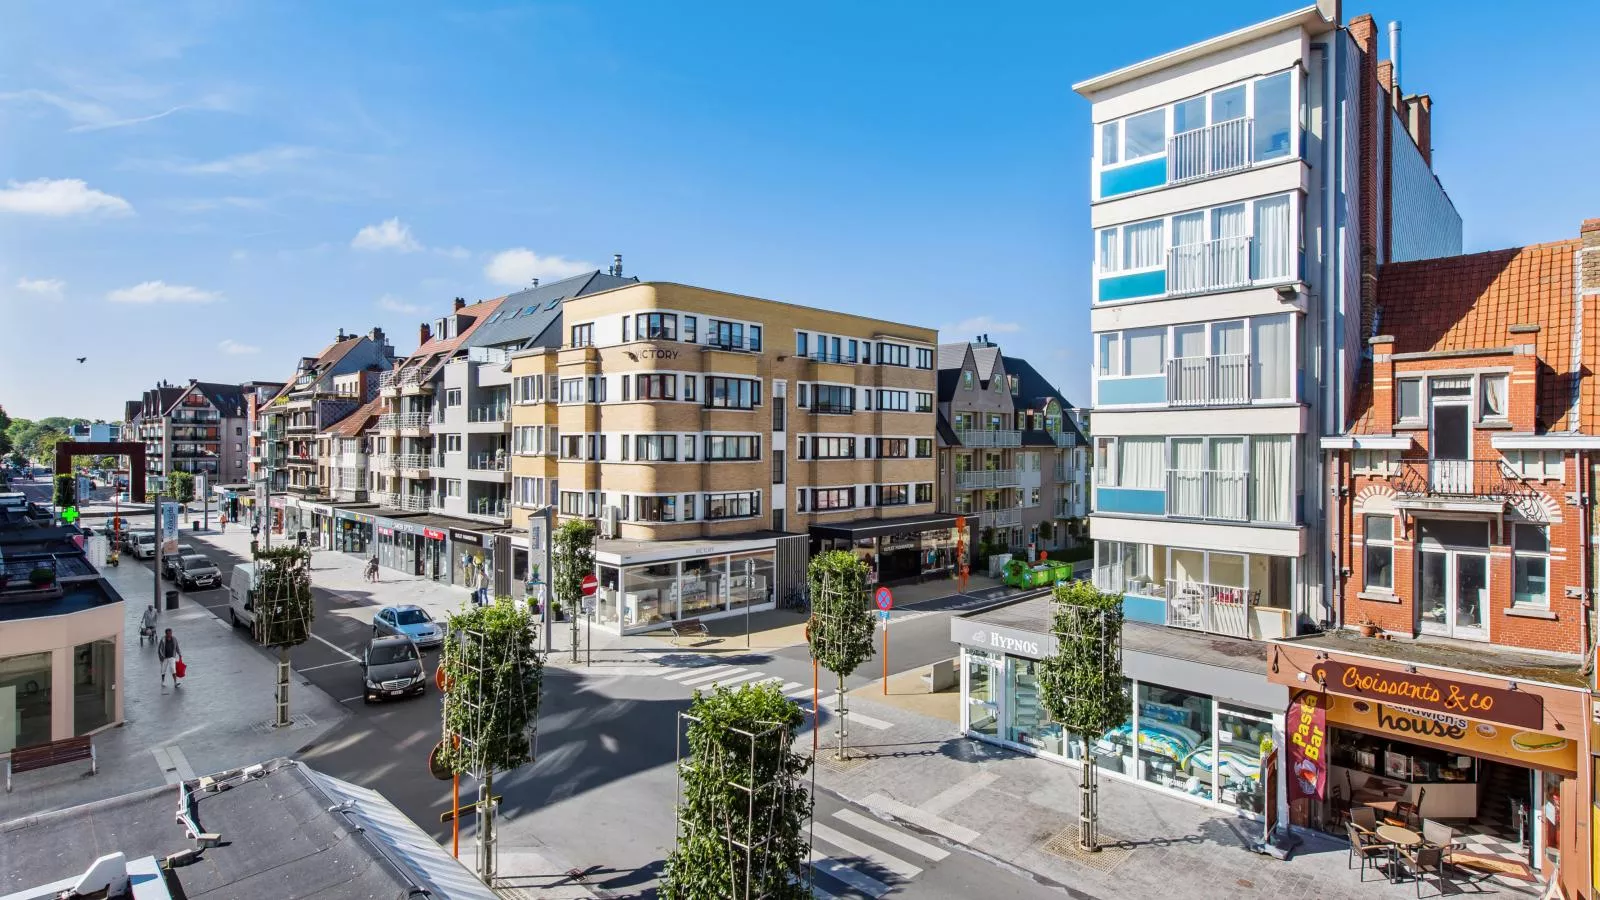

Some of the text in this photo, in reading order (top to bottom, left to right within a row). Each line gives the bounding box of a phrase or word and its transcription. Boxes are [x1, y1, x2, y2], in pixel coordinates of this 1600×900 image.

[990, 631, 1039, 655] HYPNOS
[1342, 666, 1440, 702] Croissants
[1292, 694, 1318, 748] Pasta
[1377, 703, 1466, 739] house
[1304, 725, 1324, 761] Bar
